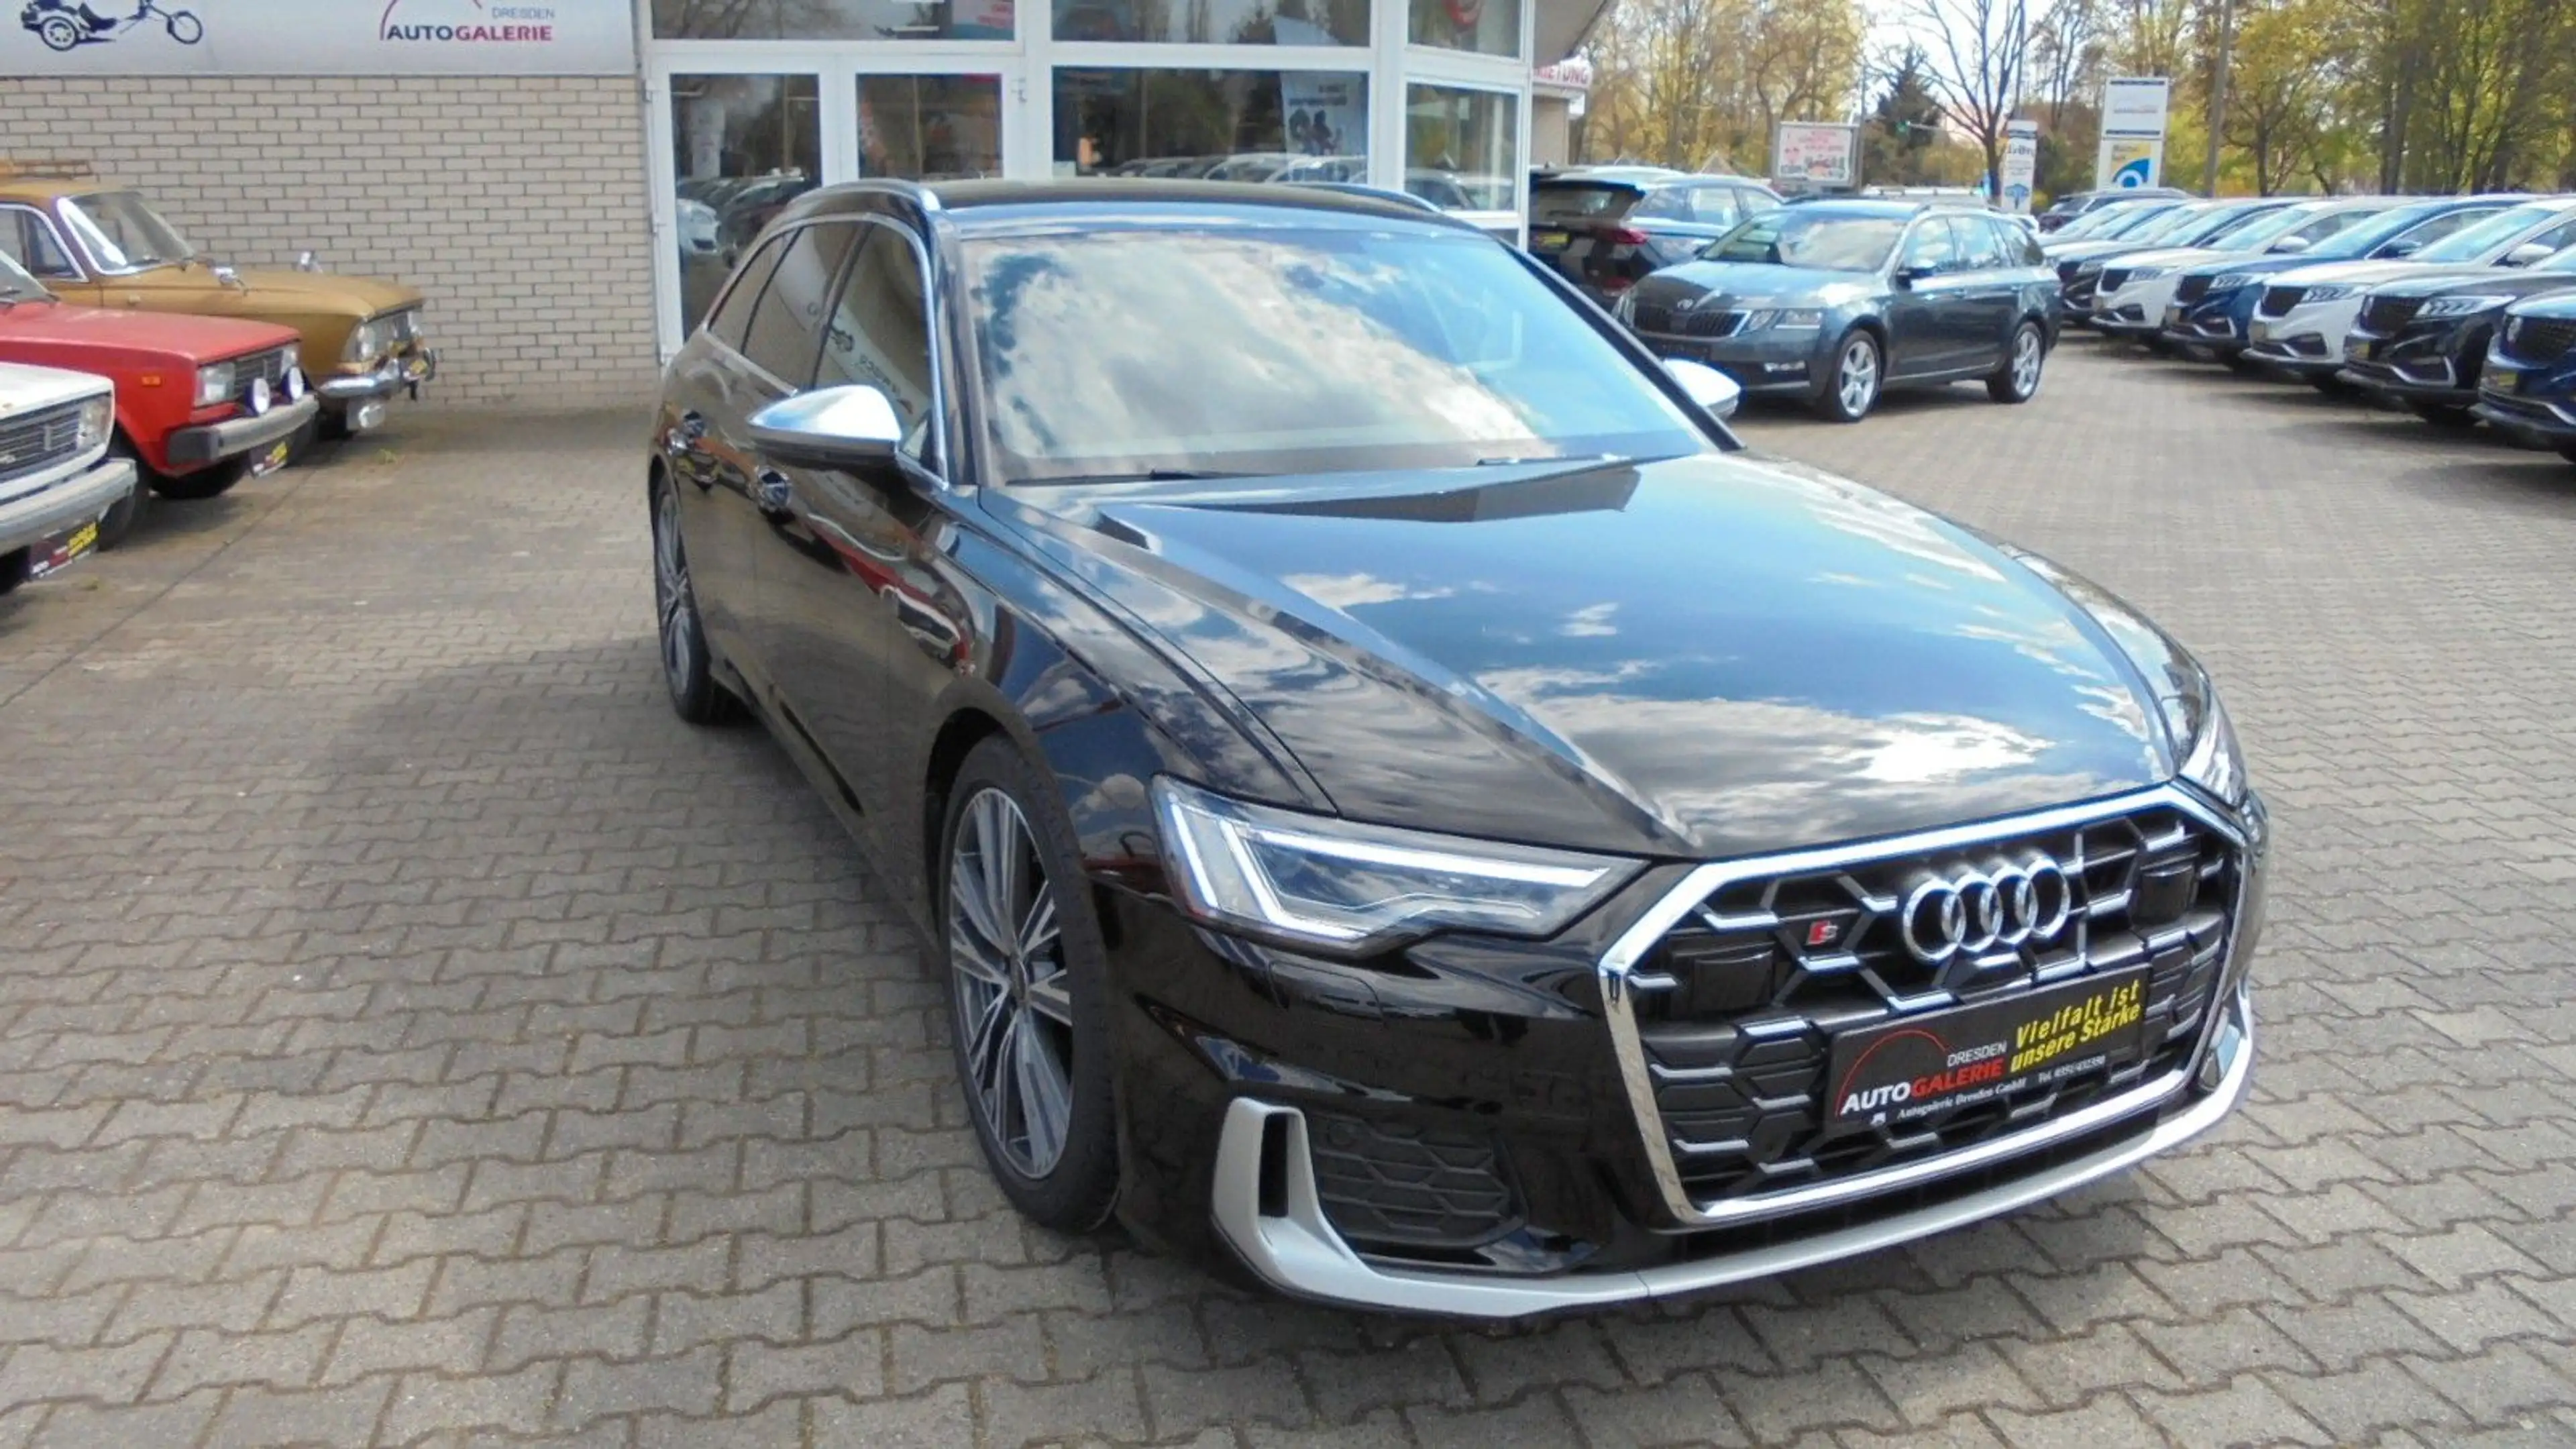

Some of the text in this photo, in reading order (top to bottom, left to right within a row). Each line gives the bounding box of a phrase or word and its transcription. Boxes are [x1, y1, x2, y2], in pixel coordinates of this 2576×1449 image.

[492, 6, 555, 19] DRESDEN
[386, 25, 553, 41] AUTOGALERIE
[2017, 979, 2140, 1049] Vielfalt ist
[1947, 1040, 2007, 1067] DRESDEN
[2010, 1030, 2076, 1073] unsere
[1840, 1059, 2004, 1116] AUTOGALERIE
